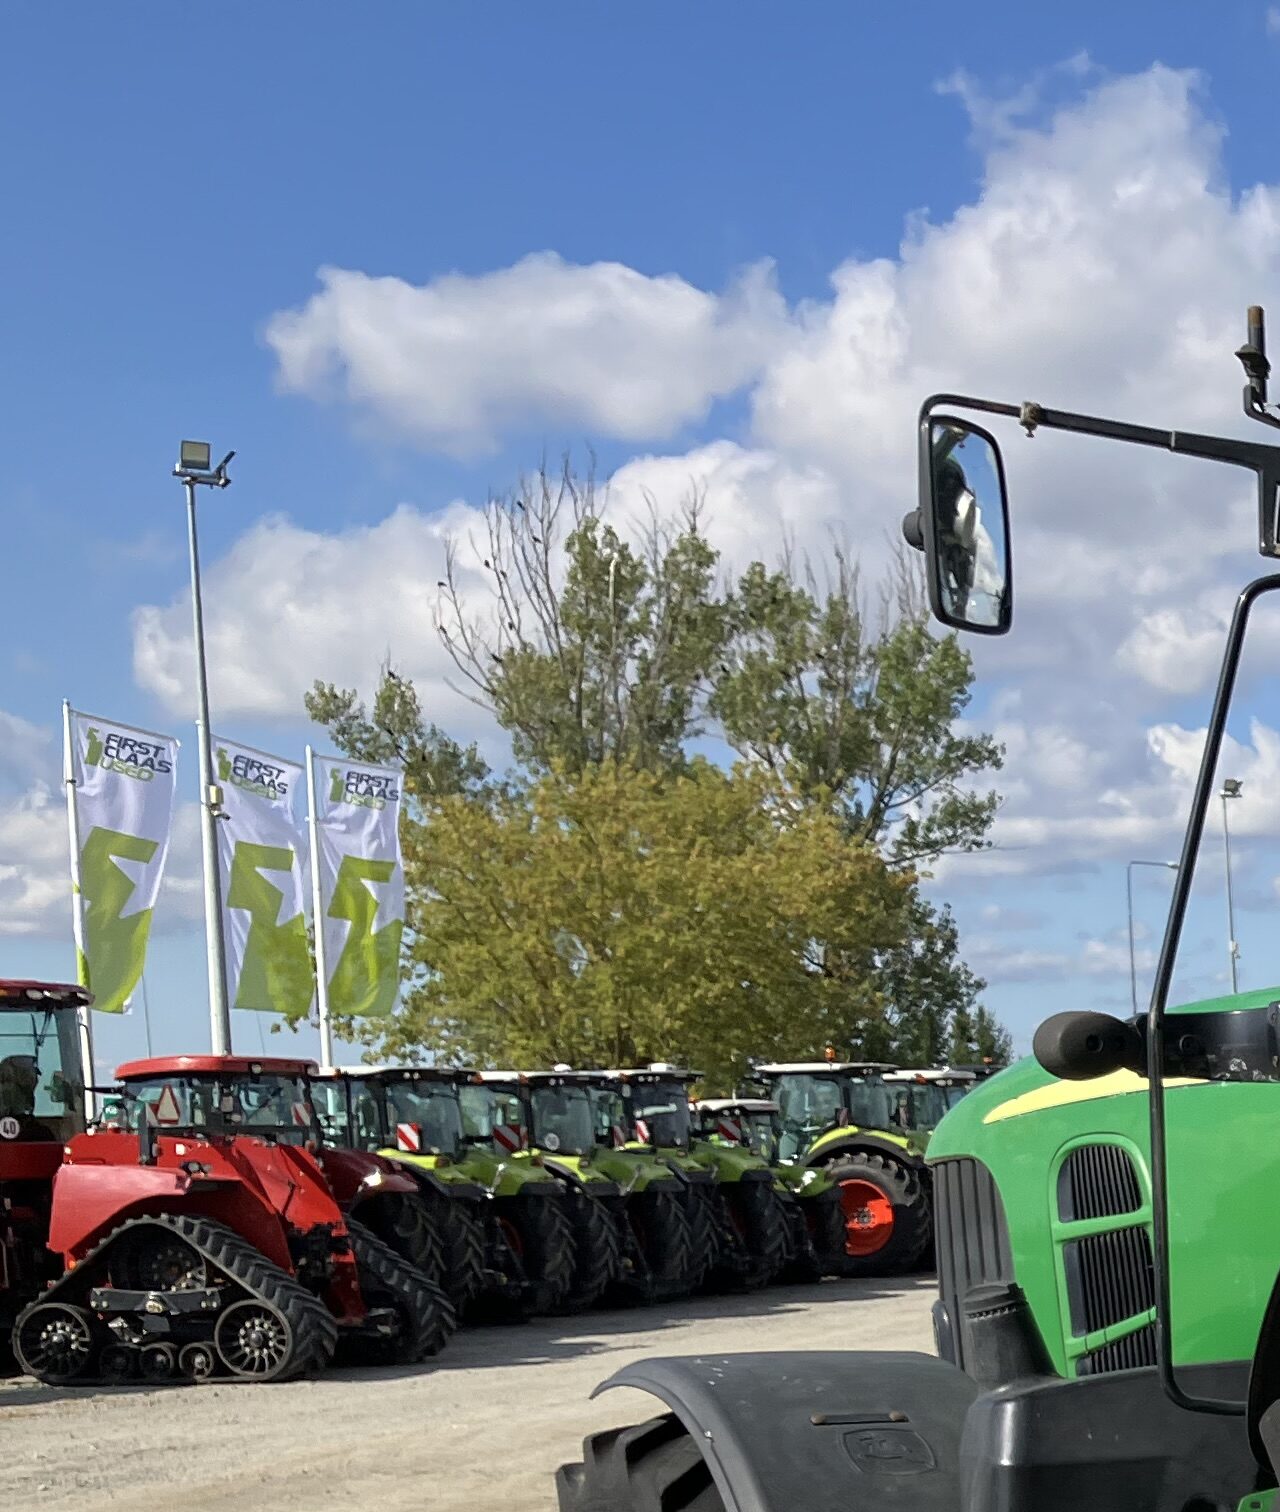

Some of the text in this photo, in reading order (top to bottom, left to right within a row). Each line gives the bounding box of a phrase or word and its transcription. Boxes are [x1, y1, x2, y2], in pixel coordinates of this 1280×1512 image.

[104, 733, 165, 758] FIRST
[104, 745, 172, 774] CLAAS
[233, 754, 286, 780] FIRST
[232, 766, 289, 795] CLAAS
[345, 782, 400, 802] CLAAS
[346, 771, 394, 788] FIRST
[2, 1121, 16, 1135] 40
